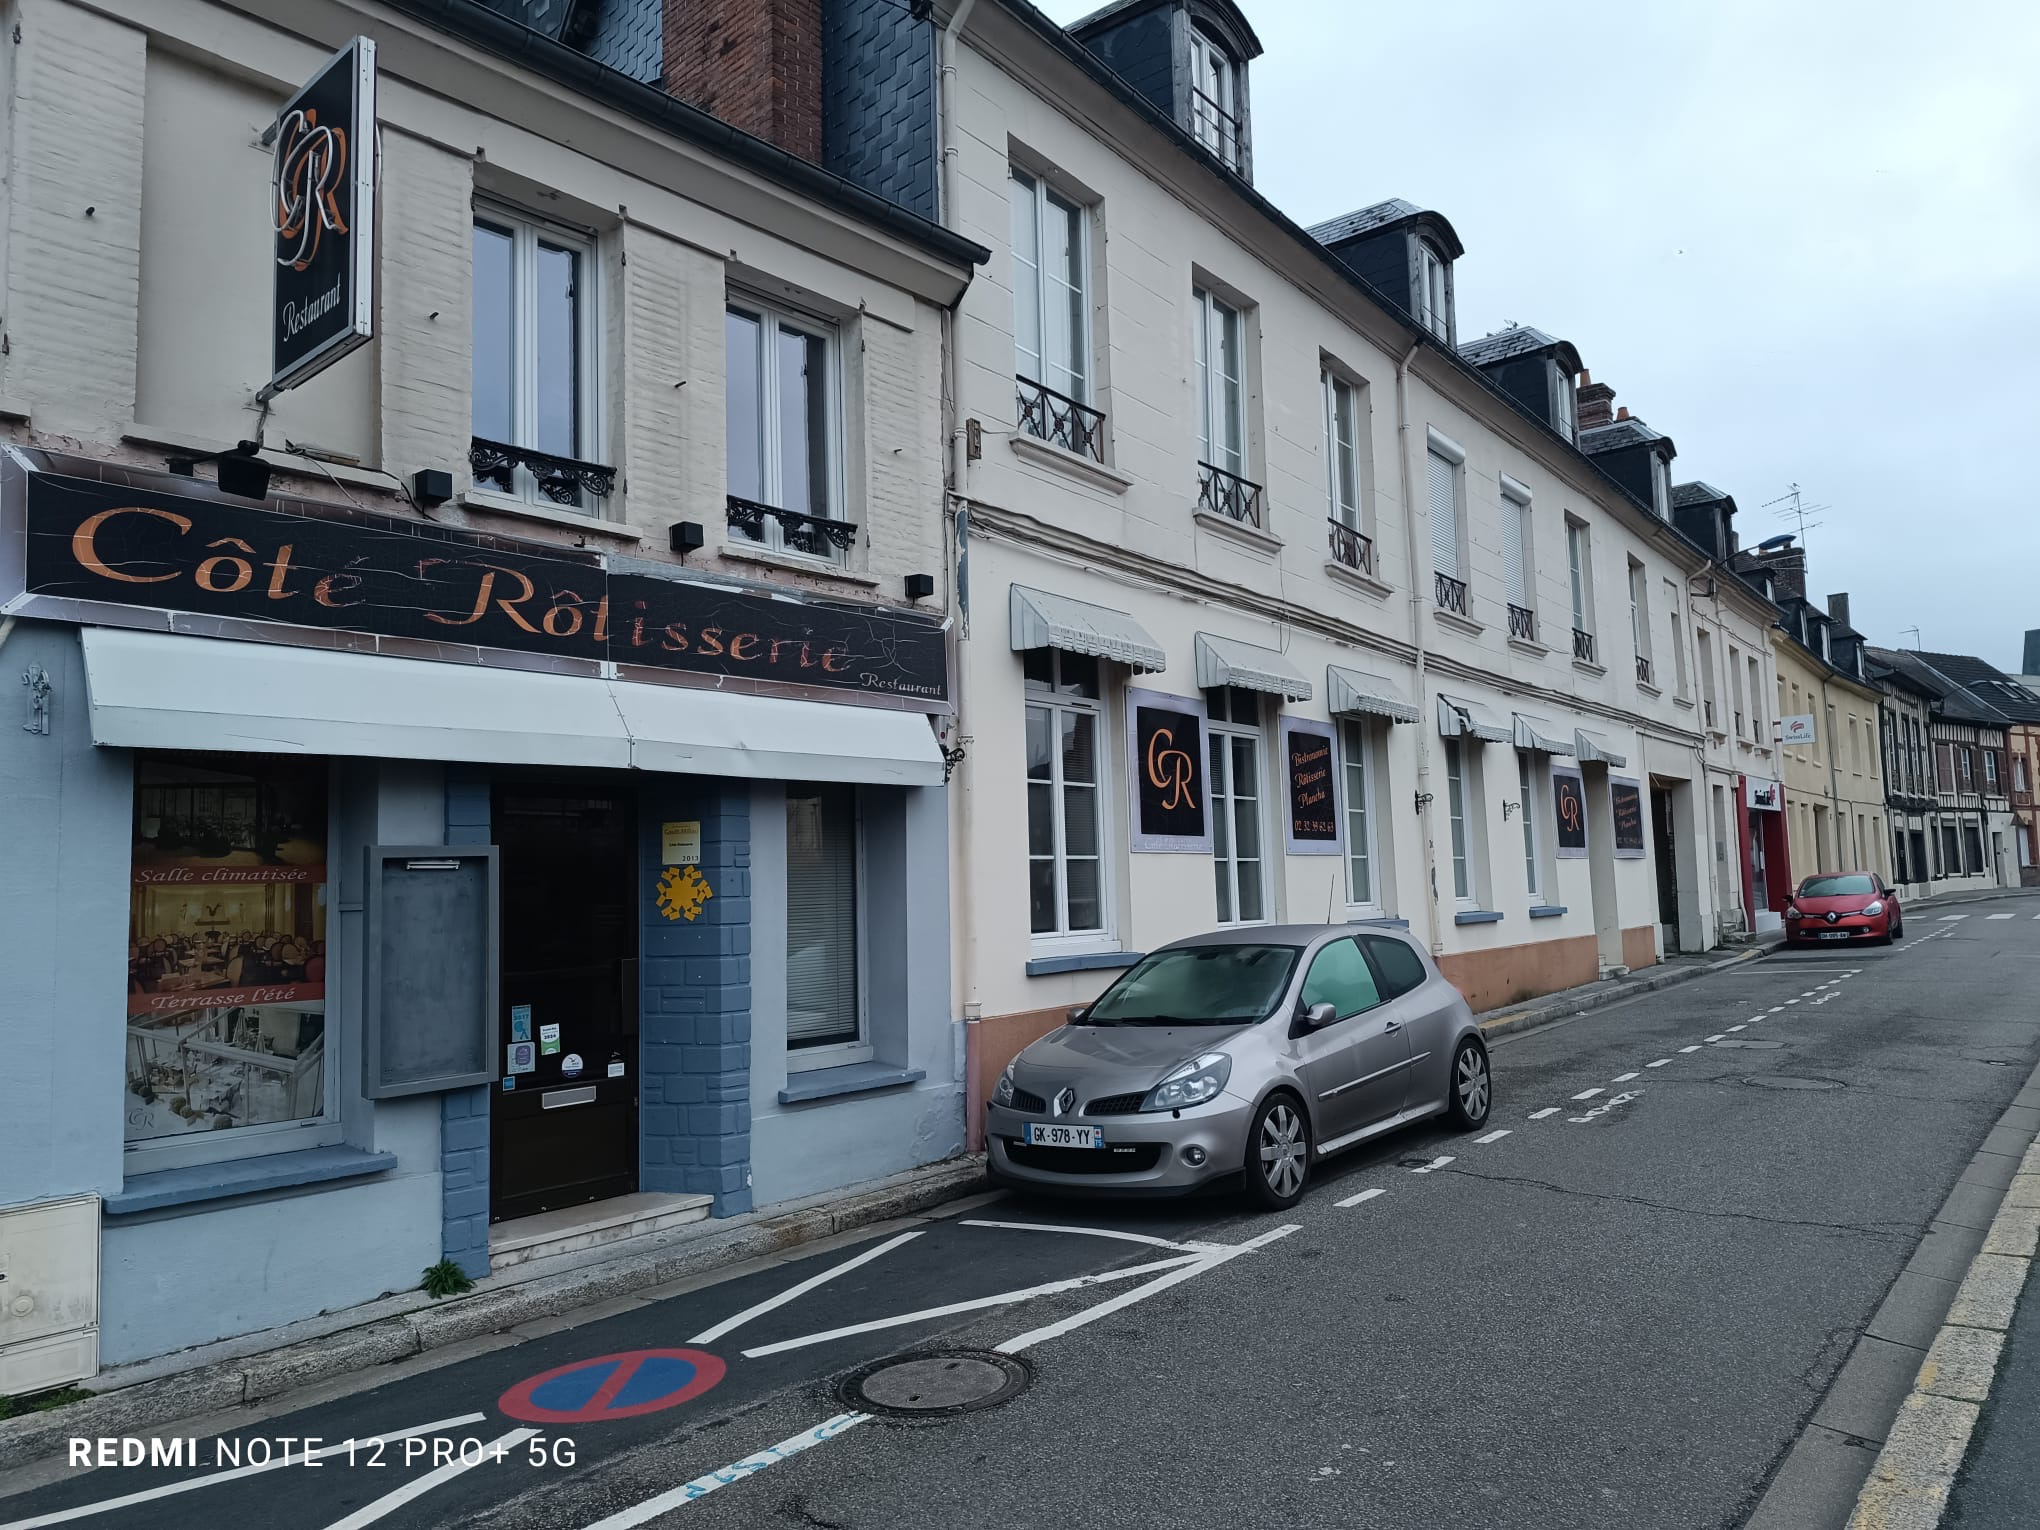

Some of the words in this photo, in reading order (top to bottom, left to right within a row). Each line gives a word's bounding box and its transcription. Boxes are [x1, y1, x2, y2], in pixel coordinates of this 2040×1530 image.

[282, 280, 341, 342] Restaurant
[72, 507, 369, 608] Côté
[414, 557, 851, 674] Rôtisserie
[859, 672, 942, 697] Restaurant
[135, 868, 196, 883] Salle
[202, 867, 308, 882] climatisée
[151, 991, 245, 1010] Terrasse
[253, 986, 297, 1003] l'été
[1034, 1127, 1090, 1145] GK-978-YY
